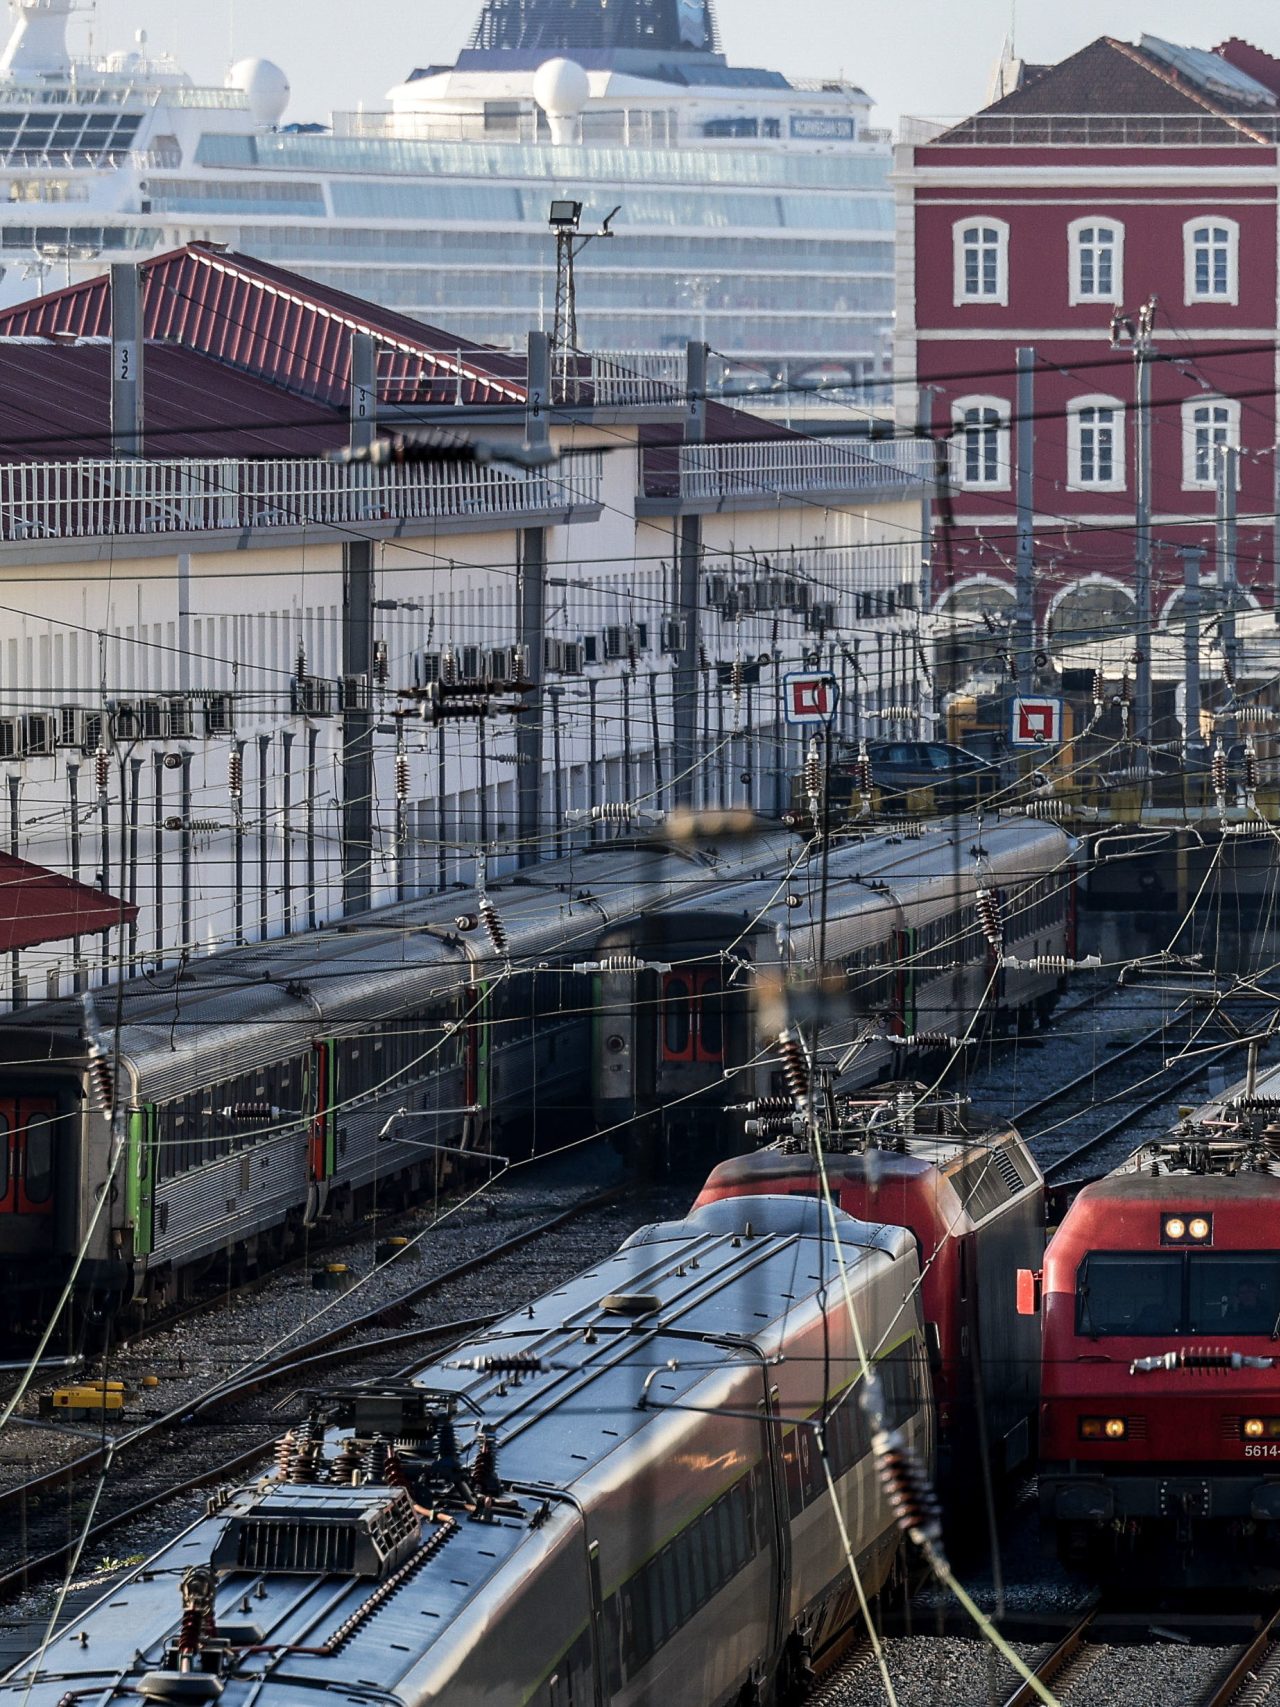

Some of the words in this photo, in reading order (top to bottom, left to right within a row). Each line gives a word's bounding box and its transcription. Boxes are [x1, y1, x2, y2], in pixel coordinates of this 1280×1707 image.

[121, 349, 129, 380] 32
[359, 388, 366, 416] 30
[533, 392, 540, 417] 28
